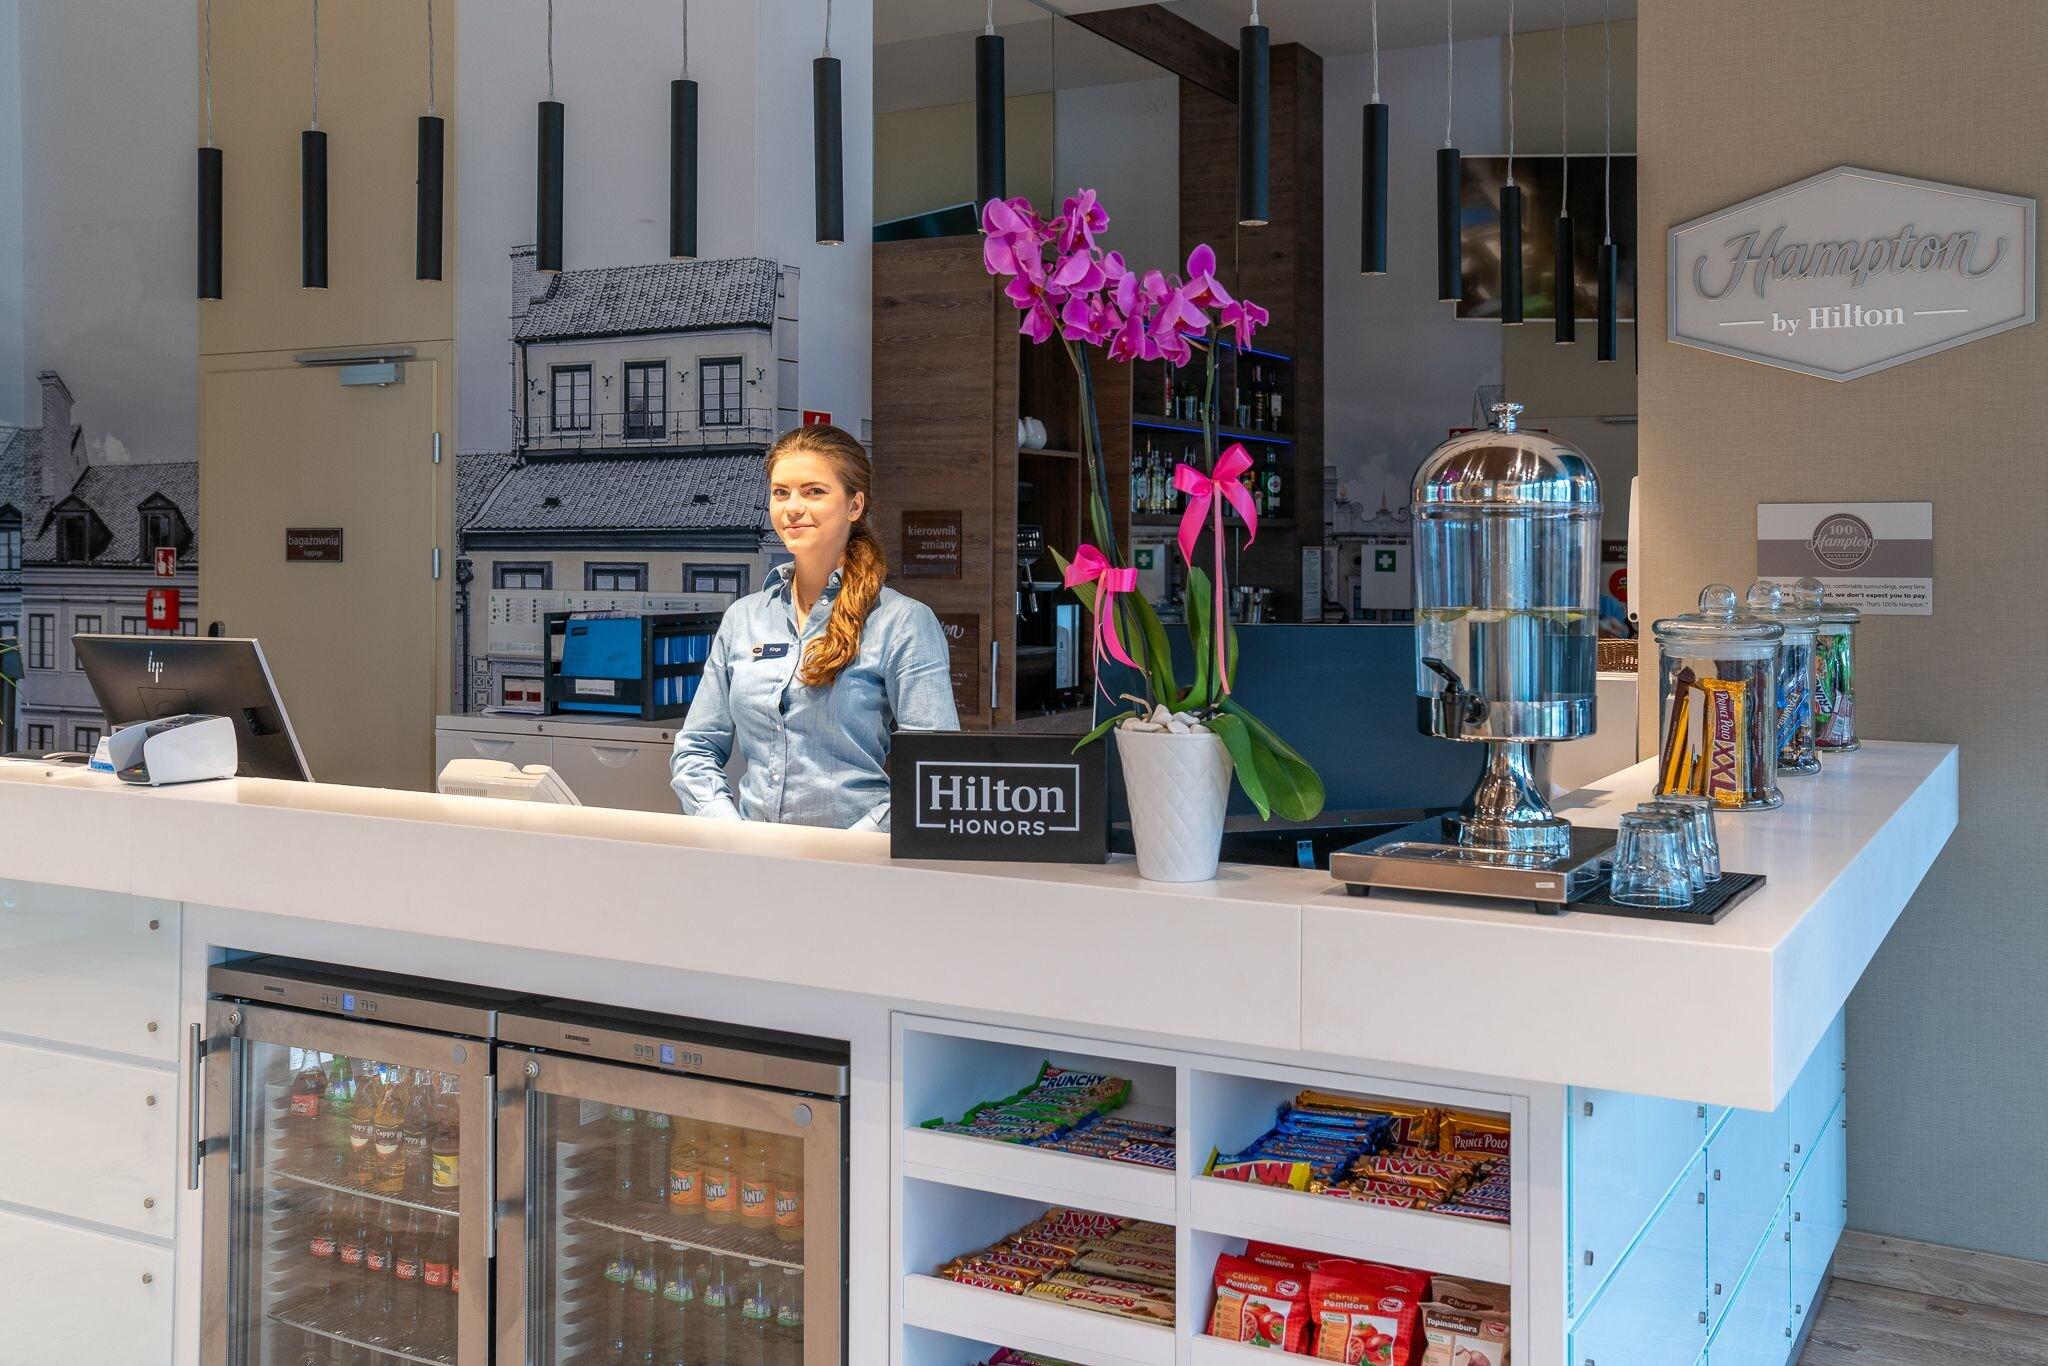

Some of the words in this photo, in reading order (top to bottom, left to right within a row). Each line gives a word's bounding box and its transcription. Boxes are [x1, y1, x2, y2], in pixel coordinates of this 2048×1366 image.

[1693, 224, 2007, 302] Hampton
[1772, 313, 1800, 336] by
[1807, 304, 1906, 330] Hilton
[908, 525, 957, 536] kierownik
[288, 534, 339, 548] bagażownia
[921, 540, 957, 551] zmiany
[1806, 534, 1878, 550] Hampton
[1715, 692, 1729, 720] PRINCE
[1720, 719, 1734, 740] POLO
[1707, 739, 1737, 799] XXL
[929, 775, 1066, 813] Hilton
[950, 819, 1045, 836] HONORS
[1040, 1074, 1107, 1088] CRUNCHY
[375, 1129, 396, 1139] Cappy
[404, 1136, 420, 1145] appy
[1453, 1135, 1483, 1149] PRINCE
[1483, 1134, 1508, 1150] POLO
[671, 1179, 692, 1191] ANTA
[706, 1184, 727, 1197] ANTA
[743, 1190, 766, 1203] ANTA
[776, 1199, 797, 1211] ANTA
[1232, 1272, 1260, 1282] Chrup
[1225, 1279, 1268, 1293] Pomidora
[1328, 1292, 1360, 1303] Chrup
[1447, 1298, 1478, 1311] Chrup
[1323, 1299, 1370, 1311] Pomidora
[1426, 1318, 1478, 1333] Topinambura
